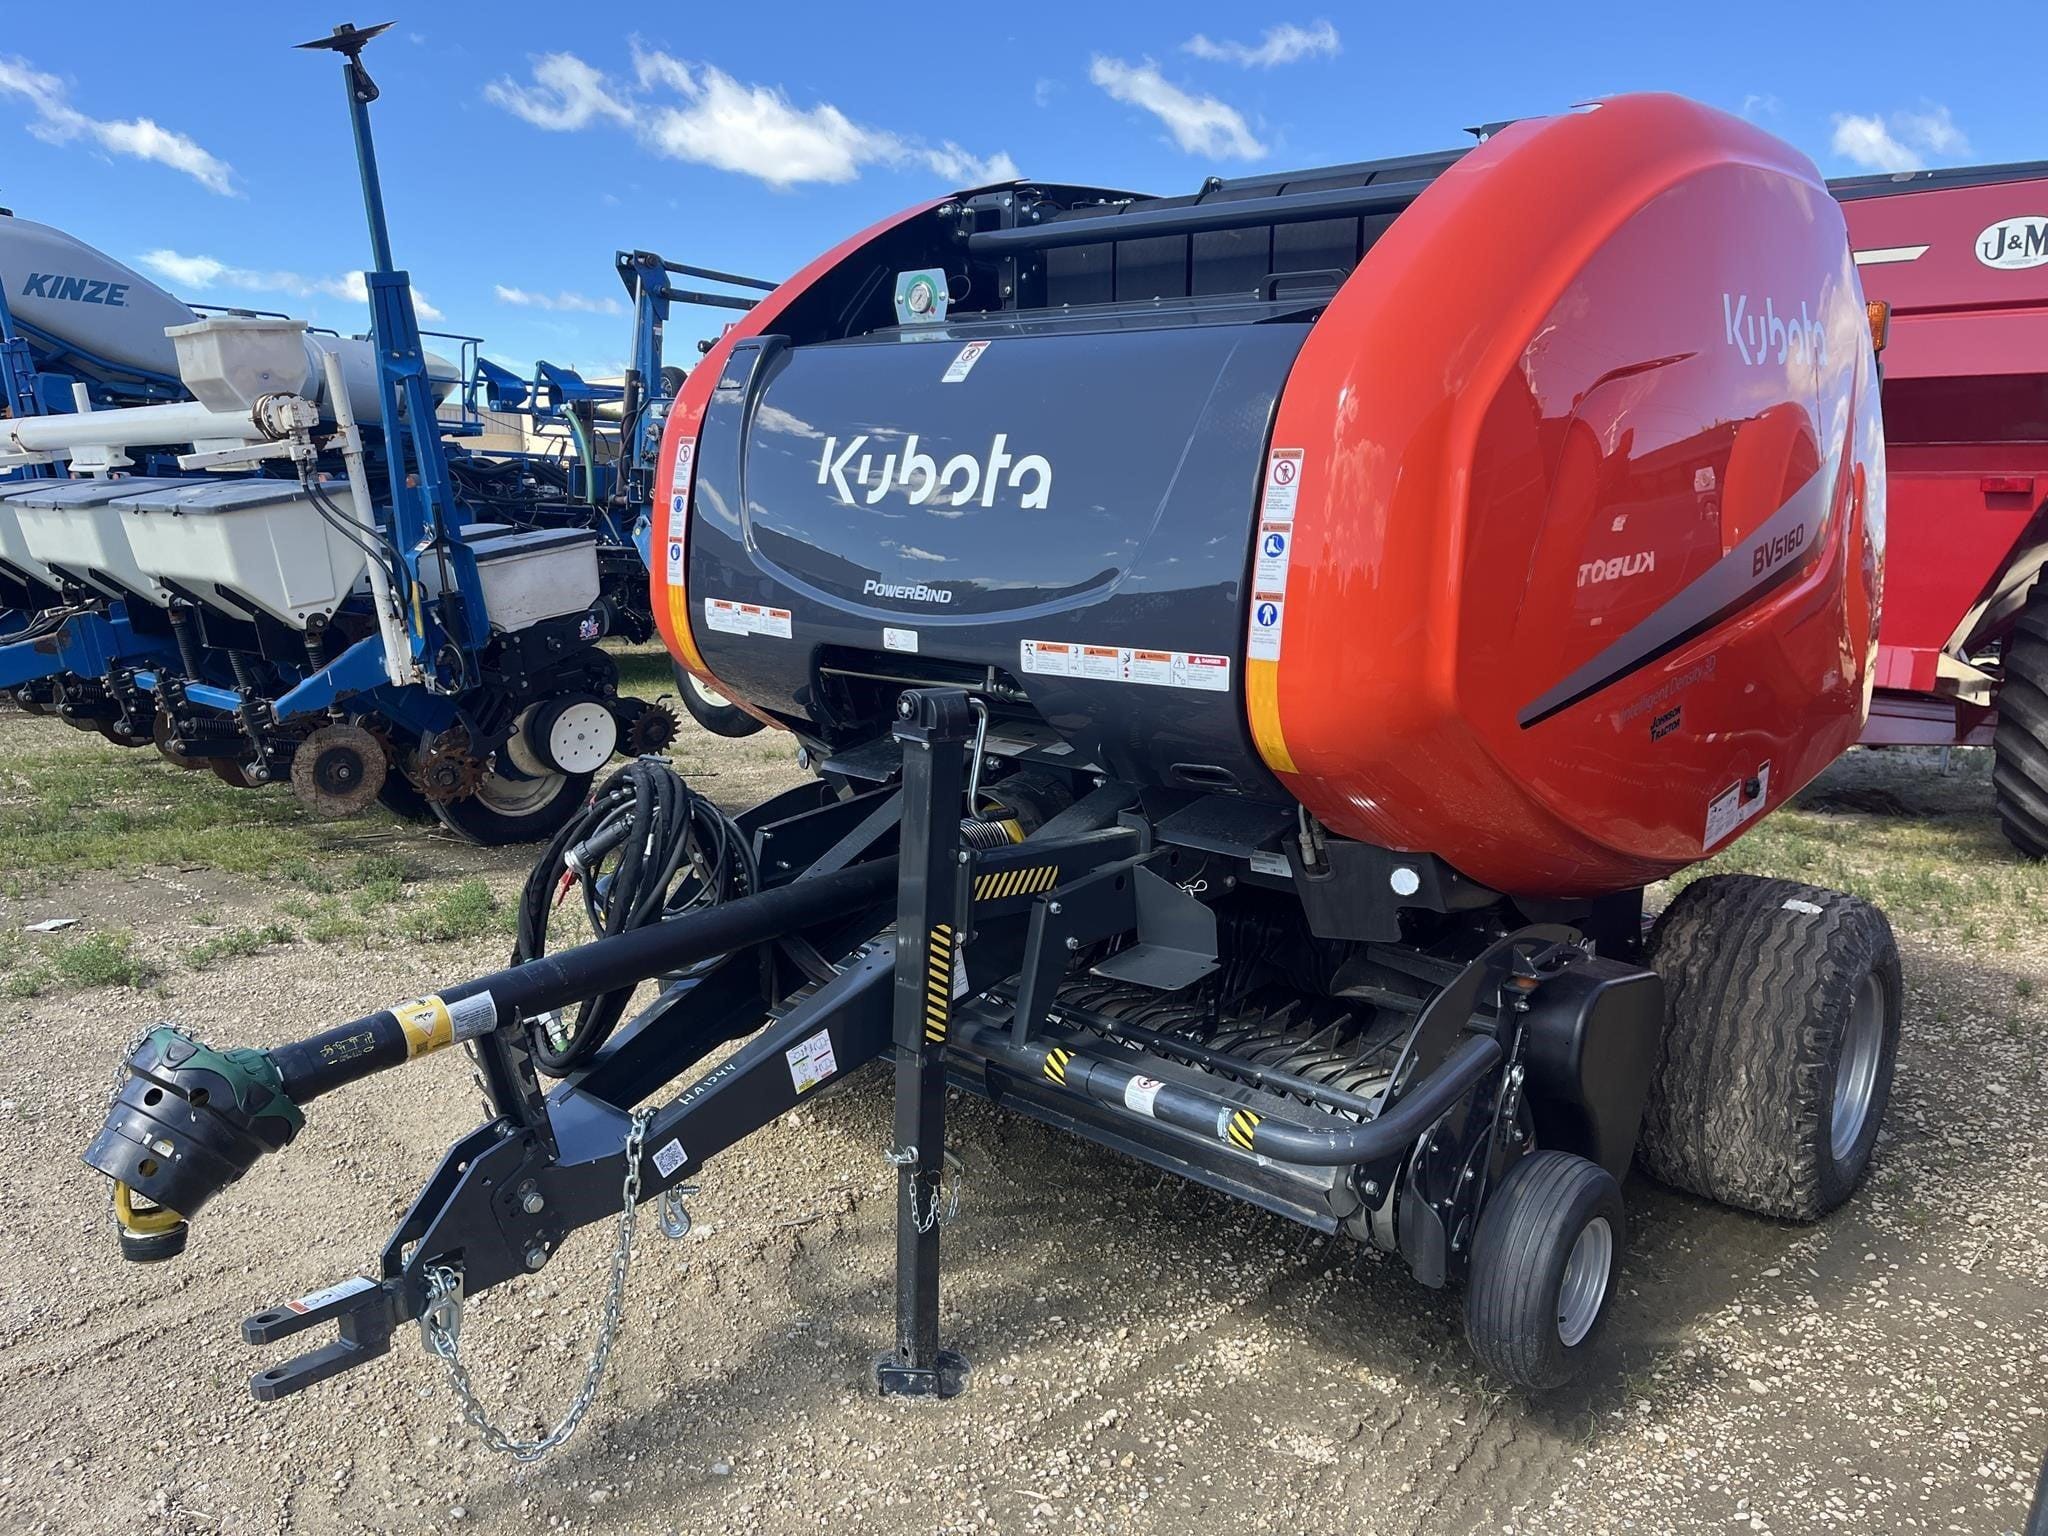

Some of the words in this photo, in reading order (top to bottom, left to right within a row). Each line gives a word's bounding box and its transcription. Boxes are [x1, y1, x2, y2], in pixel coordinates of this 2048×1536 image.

[1982, 223, 2048, 261] J&M
[21, 272, 130, 307] KINZE
[1722, 293, 1829, 366] Kubota
[817, 433, 1053, 510] Kubota
[1751, 522, 1804, 578] BV5160
[1201, 657, 1222, 665] DANGER
